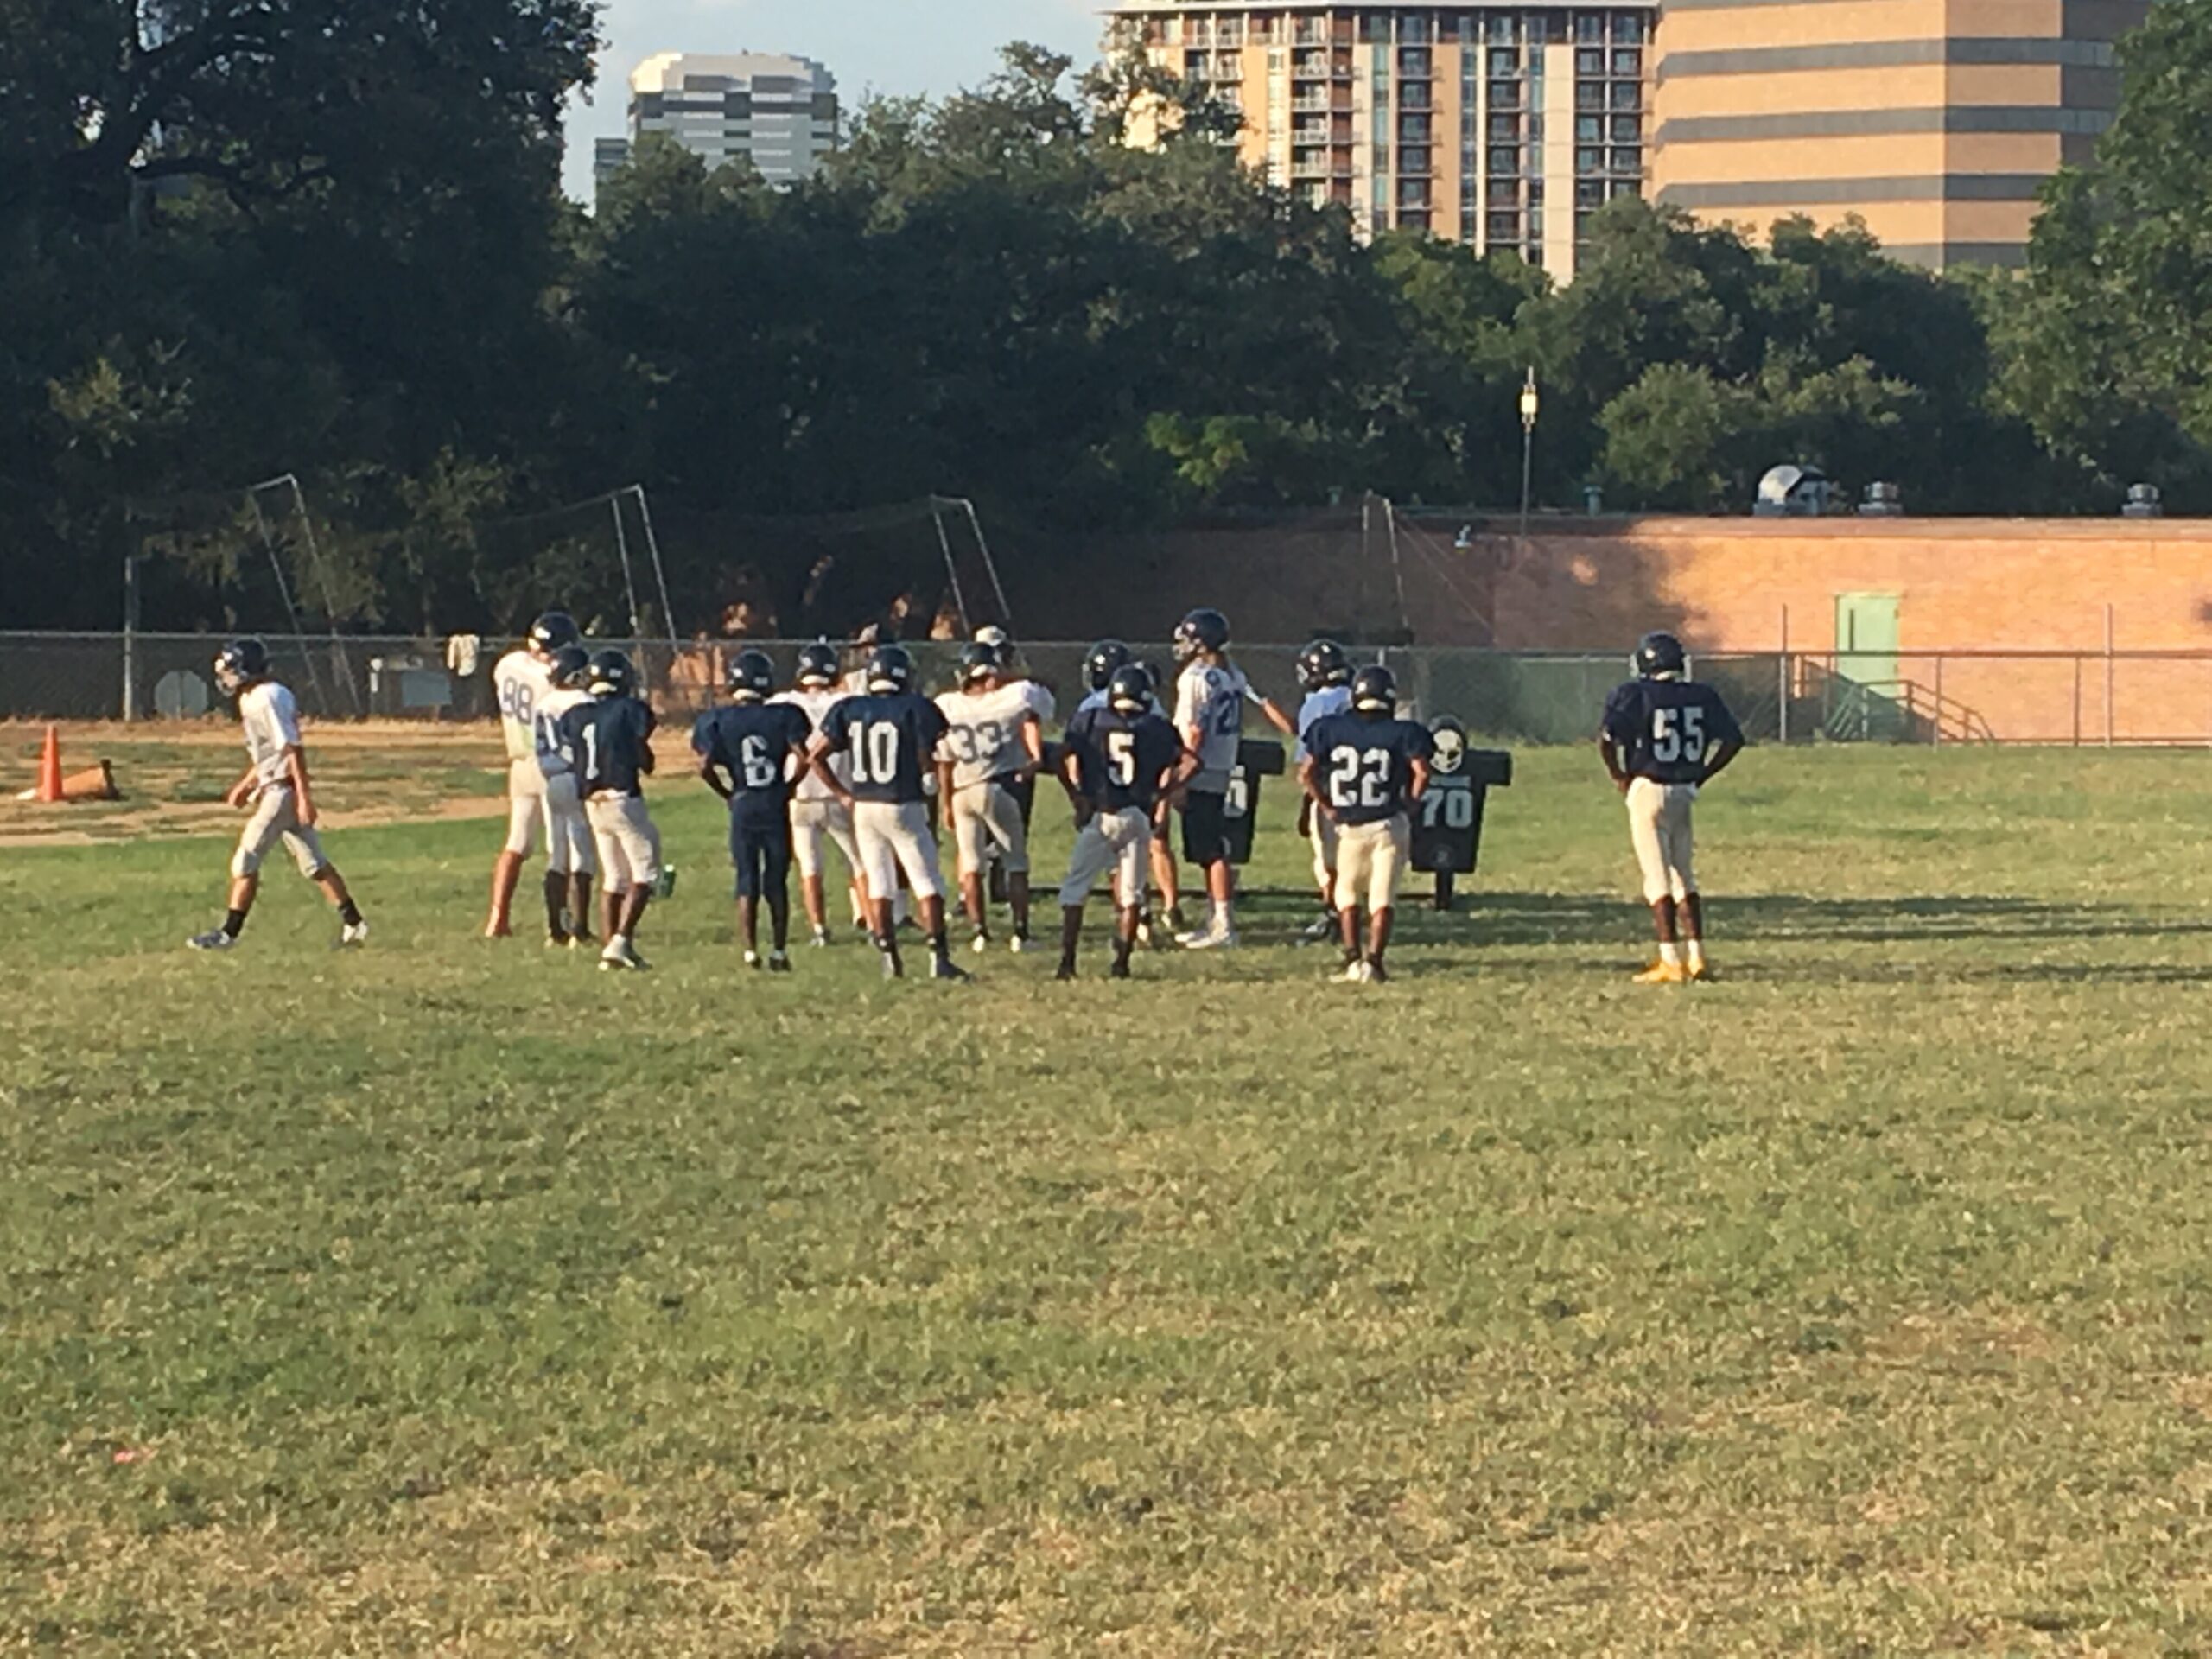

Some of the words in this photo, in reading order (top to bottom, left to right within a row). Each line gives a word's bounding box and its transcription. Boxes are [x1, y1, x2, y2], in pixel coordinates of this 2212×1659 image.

[582, 722, 599, 779] 1
[741, 735, 776, 787] 6
[849, 721, 899, 784] 10
[950, 720, 1002, 764] 33
[1109, 731, 1135, 786] 5
[1654, 706, 1703, 762] 55
[1330, 745, 1390, 807] 22
[1421, 788, 1473, 828] 70
